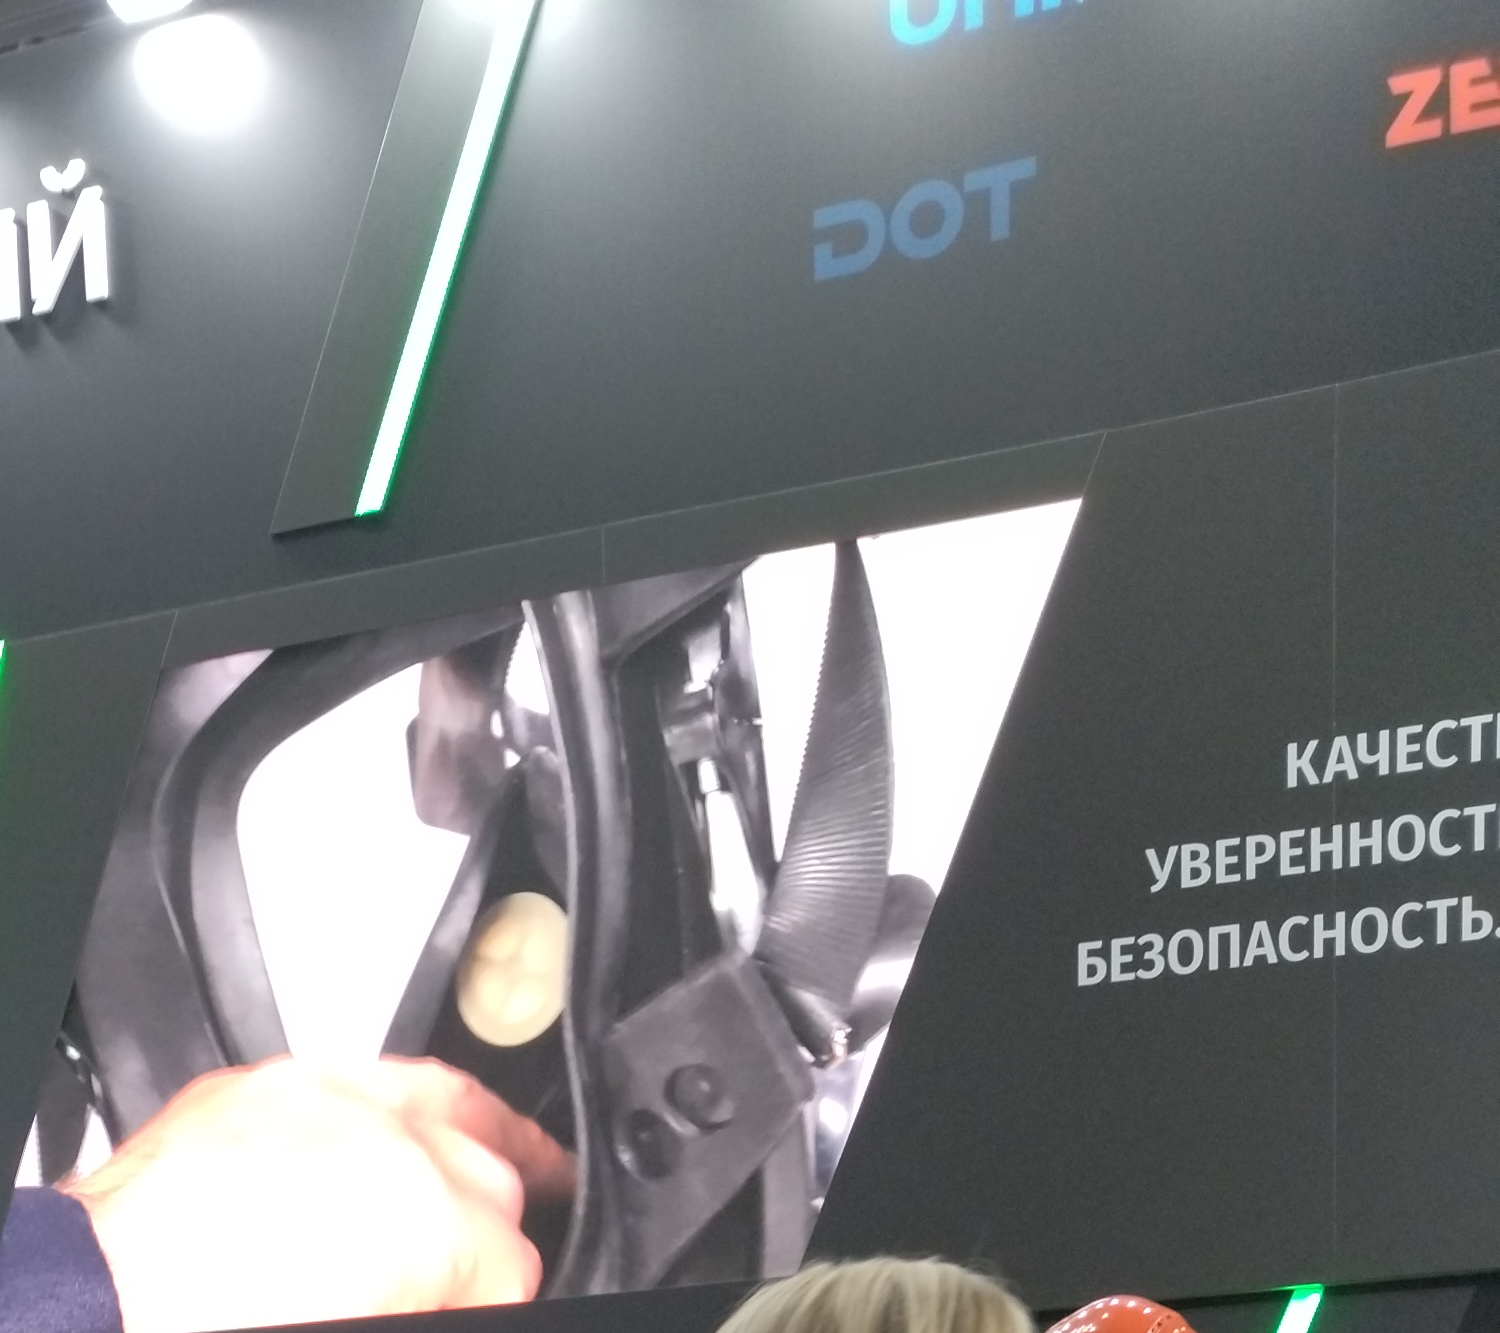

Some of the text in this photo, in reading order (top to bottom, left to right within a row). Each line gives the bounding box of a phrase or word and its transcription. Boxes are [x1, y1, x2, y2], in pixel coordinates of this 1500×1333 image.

[812, 155, 1038, 281] DOT
[1286, 712, 1500, 789] КАЧЕСТ
[1144, 803, 1500, 893] УВЕРЕННОСТ
